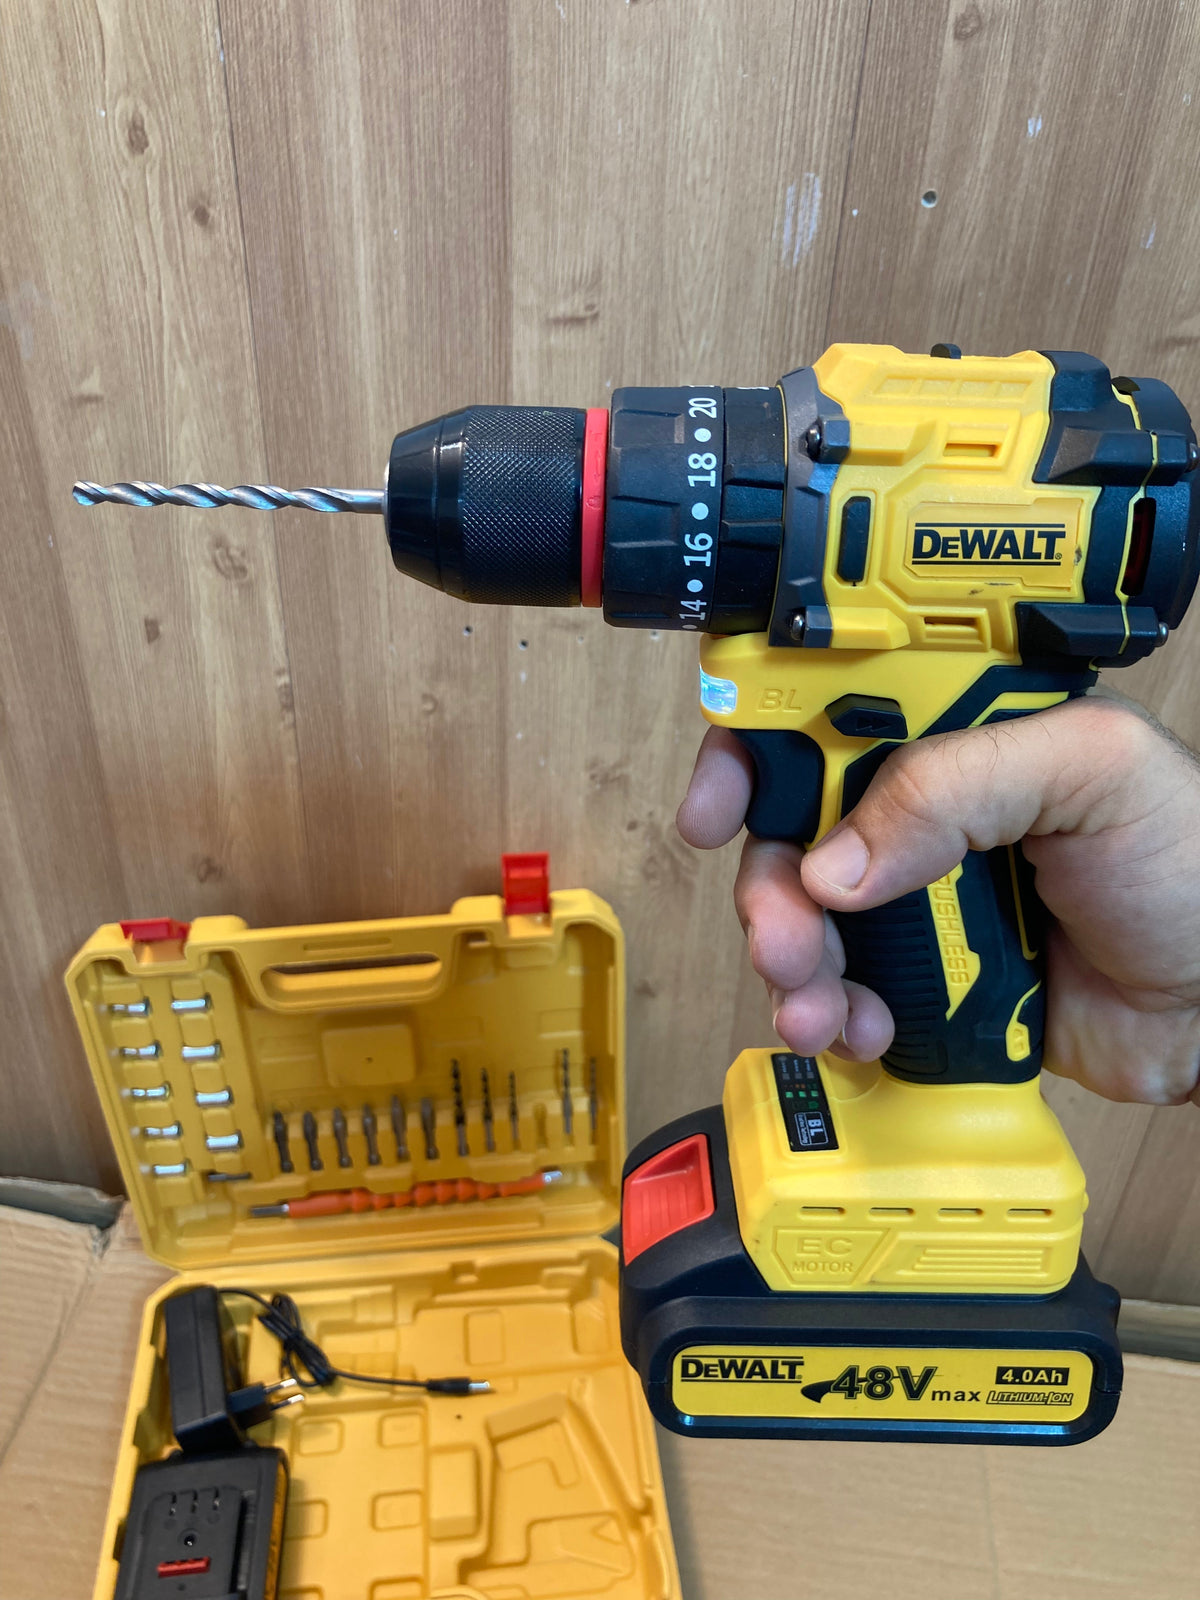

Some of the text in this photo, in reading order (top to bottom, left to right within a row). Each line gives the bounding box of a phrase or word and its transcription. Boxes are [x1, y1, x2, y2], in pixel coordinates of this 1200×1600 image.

[688, 397, 717, 419] 20
[687, 452, 717, 488] 18
[683, 534, 713, 567] 16
[679, 599, 707, 621] 14
[756, 688, 802, 712] BL
[807, 1118, 824, 1137] BL
[796, 1236, 853, 1256] EC
[792, 1260, 853, 1274] MOTOR
[830, 1365, 981, 1403] 48V max
[1001, 1369, 1064, 1385] 4.0Ah
[985, 1390, 1074, 1406] LITHIUM-ION
